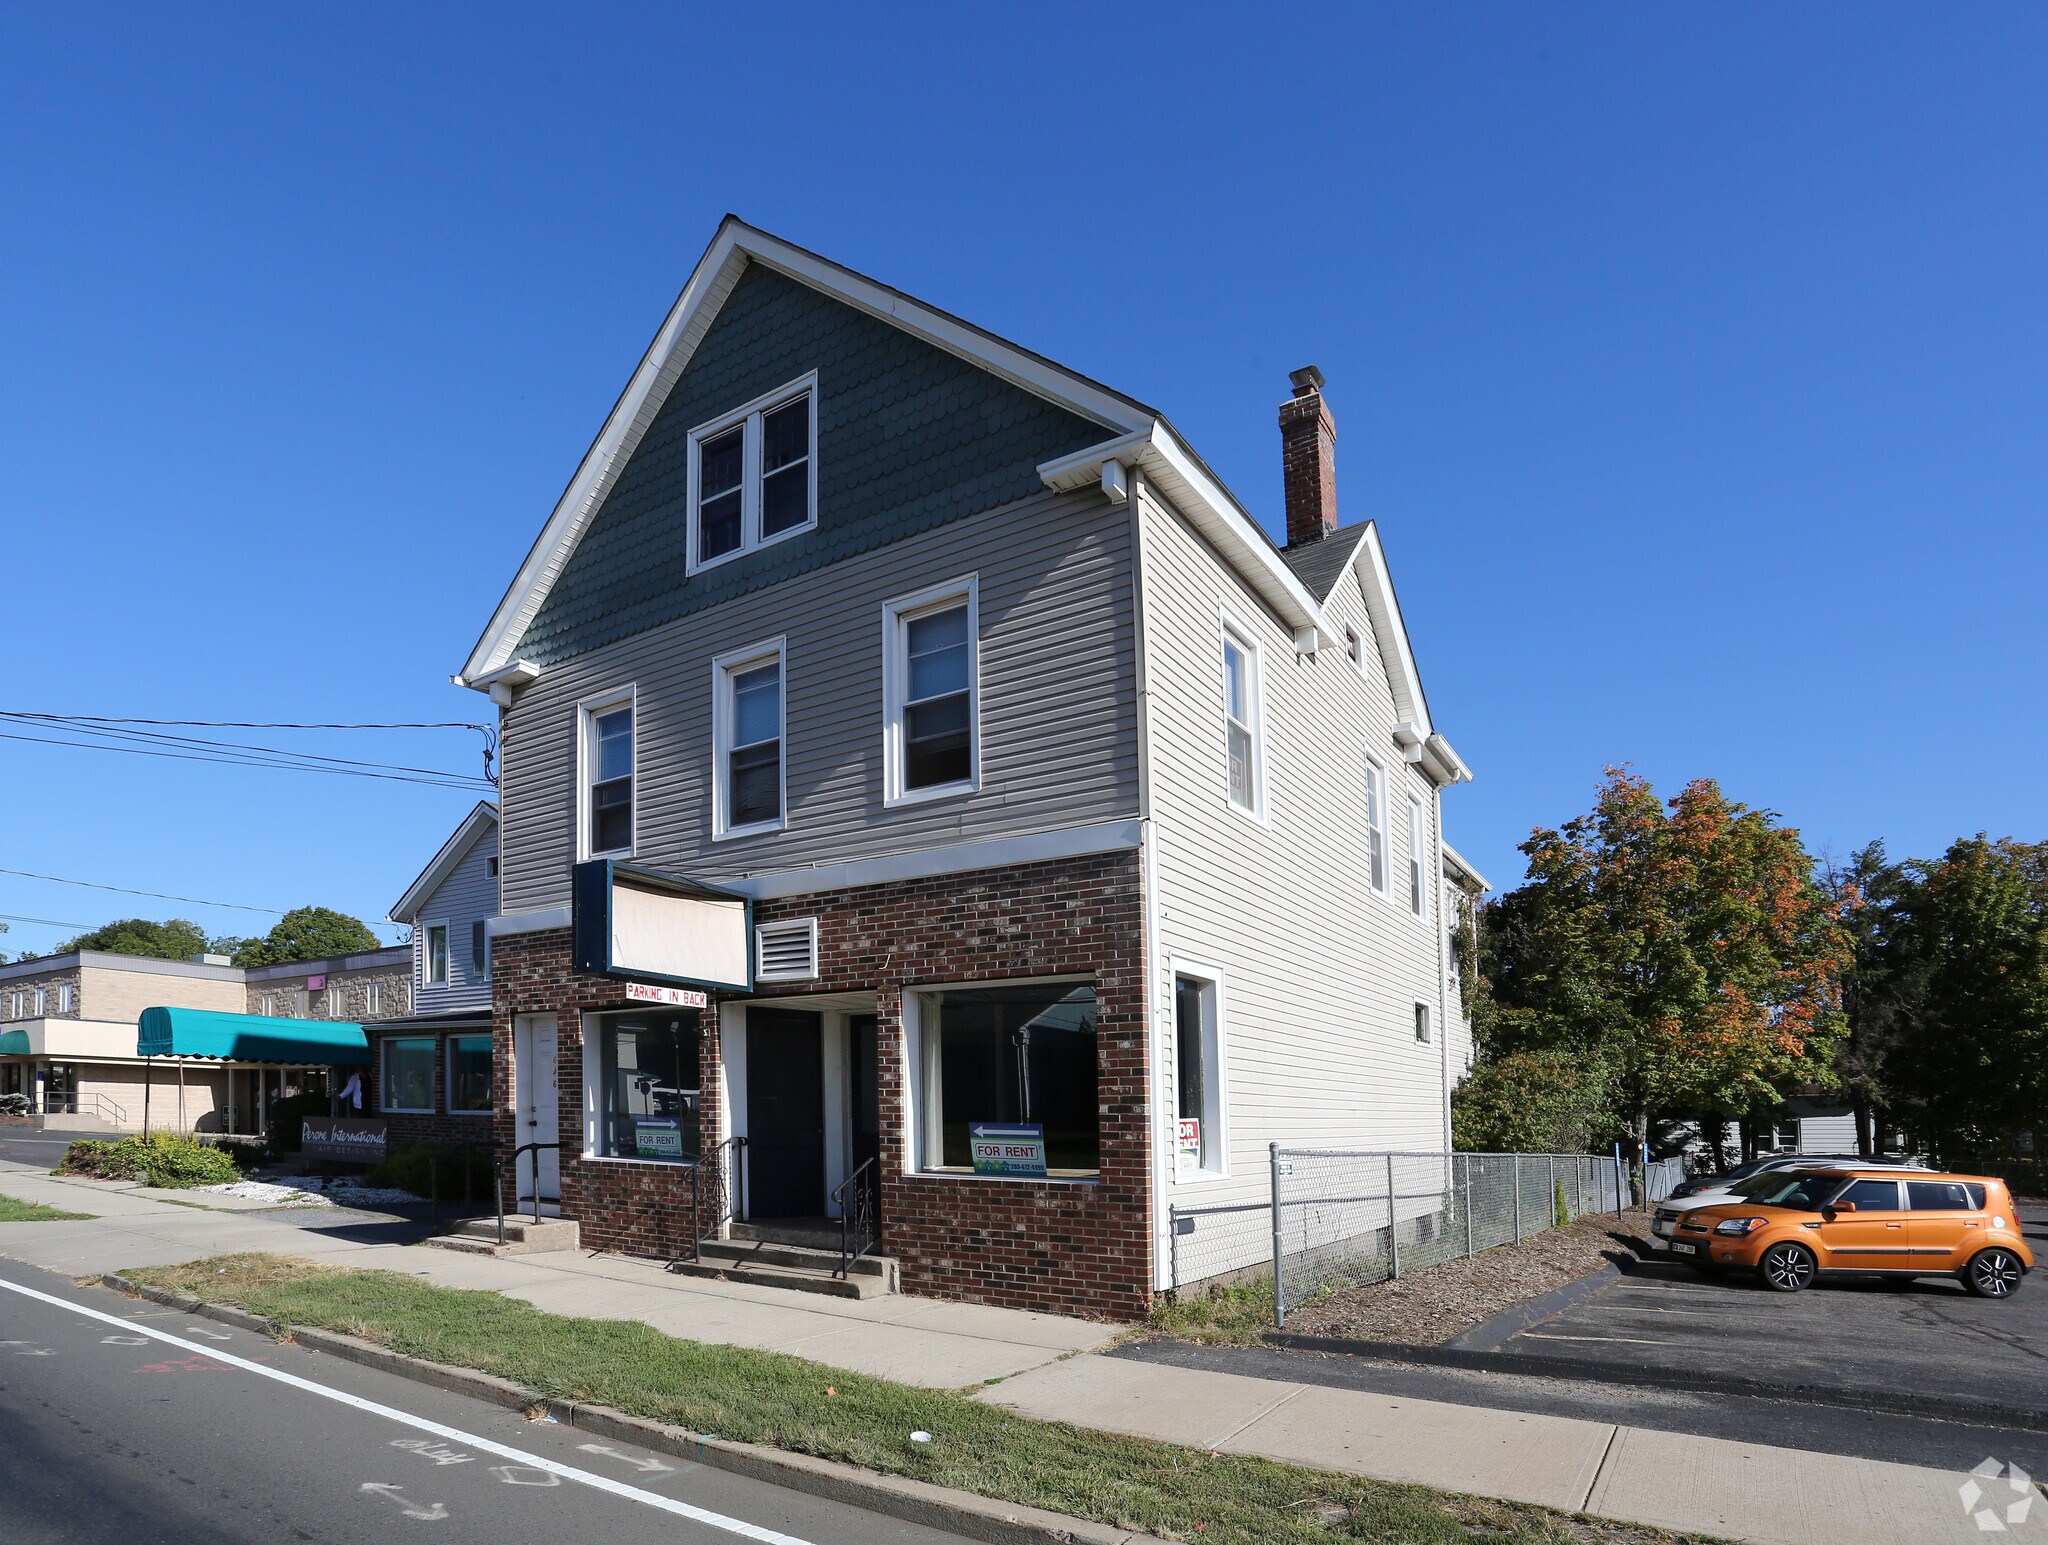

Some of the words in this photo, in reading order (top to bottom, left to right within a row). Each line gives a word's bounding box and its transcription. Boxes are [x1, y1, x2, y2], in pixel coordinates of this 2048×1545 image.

[628, 985, 662, 1001] PARKING
[669, 990, 679, 1003] IN
[683, 992, 705, 1006] BACK
[302, 1121, 327, 1141] Perone
[331, 1124, 387, 1143] International
[1179, 1123, 1194, 1137] OR
[639, 1135, 654, 1144] FOR
[656, 1136, 675, 1145] RENT
[977, 1146, 1000, 1156] FOR
[1005, 1147, 1035, 1157] RENT
